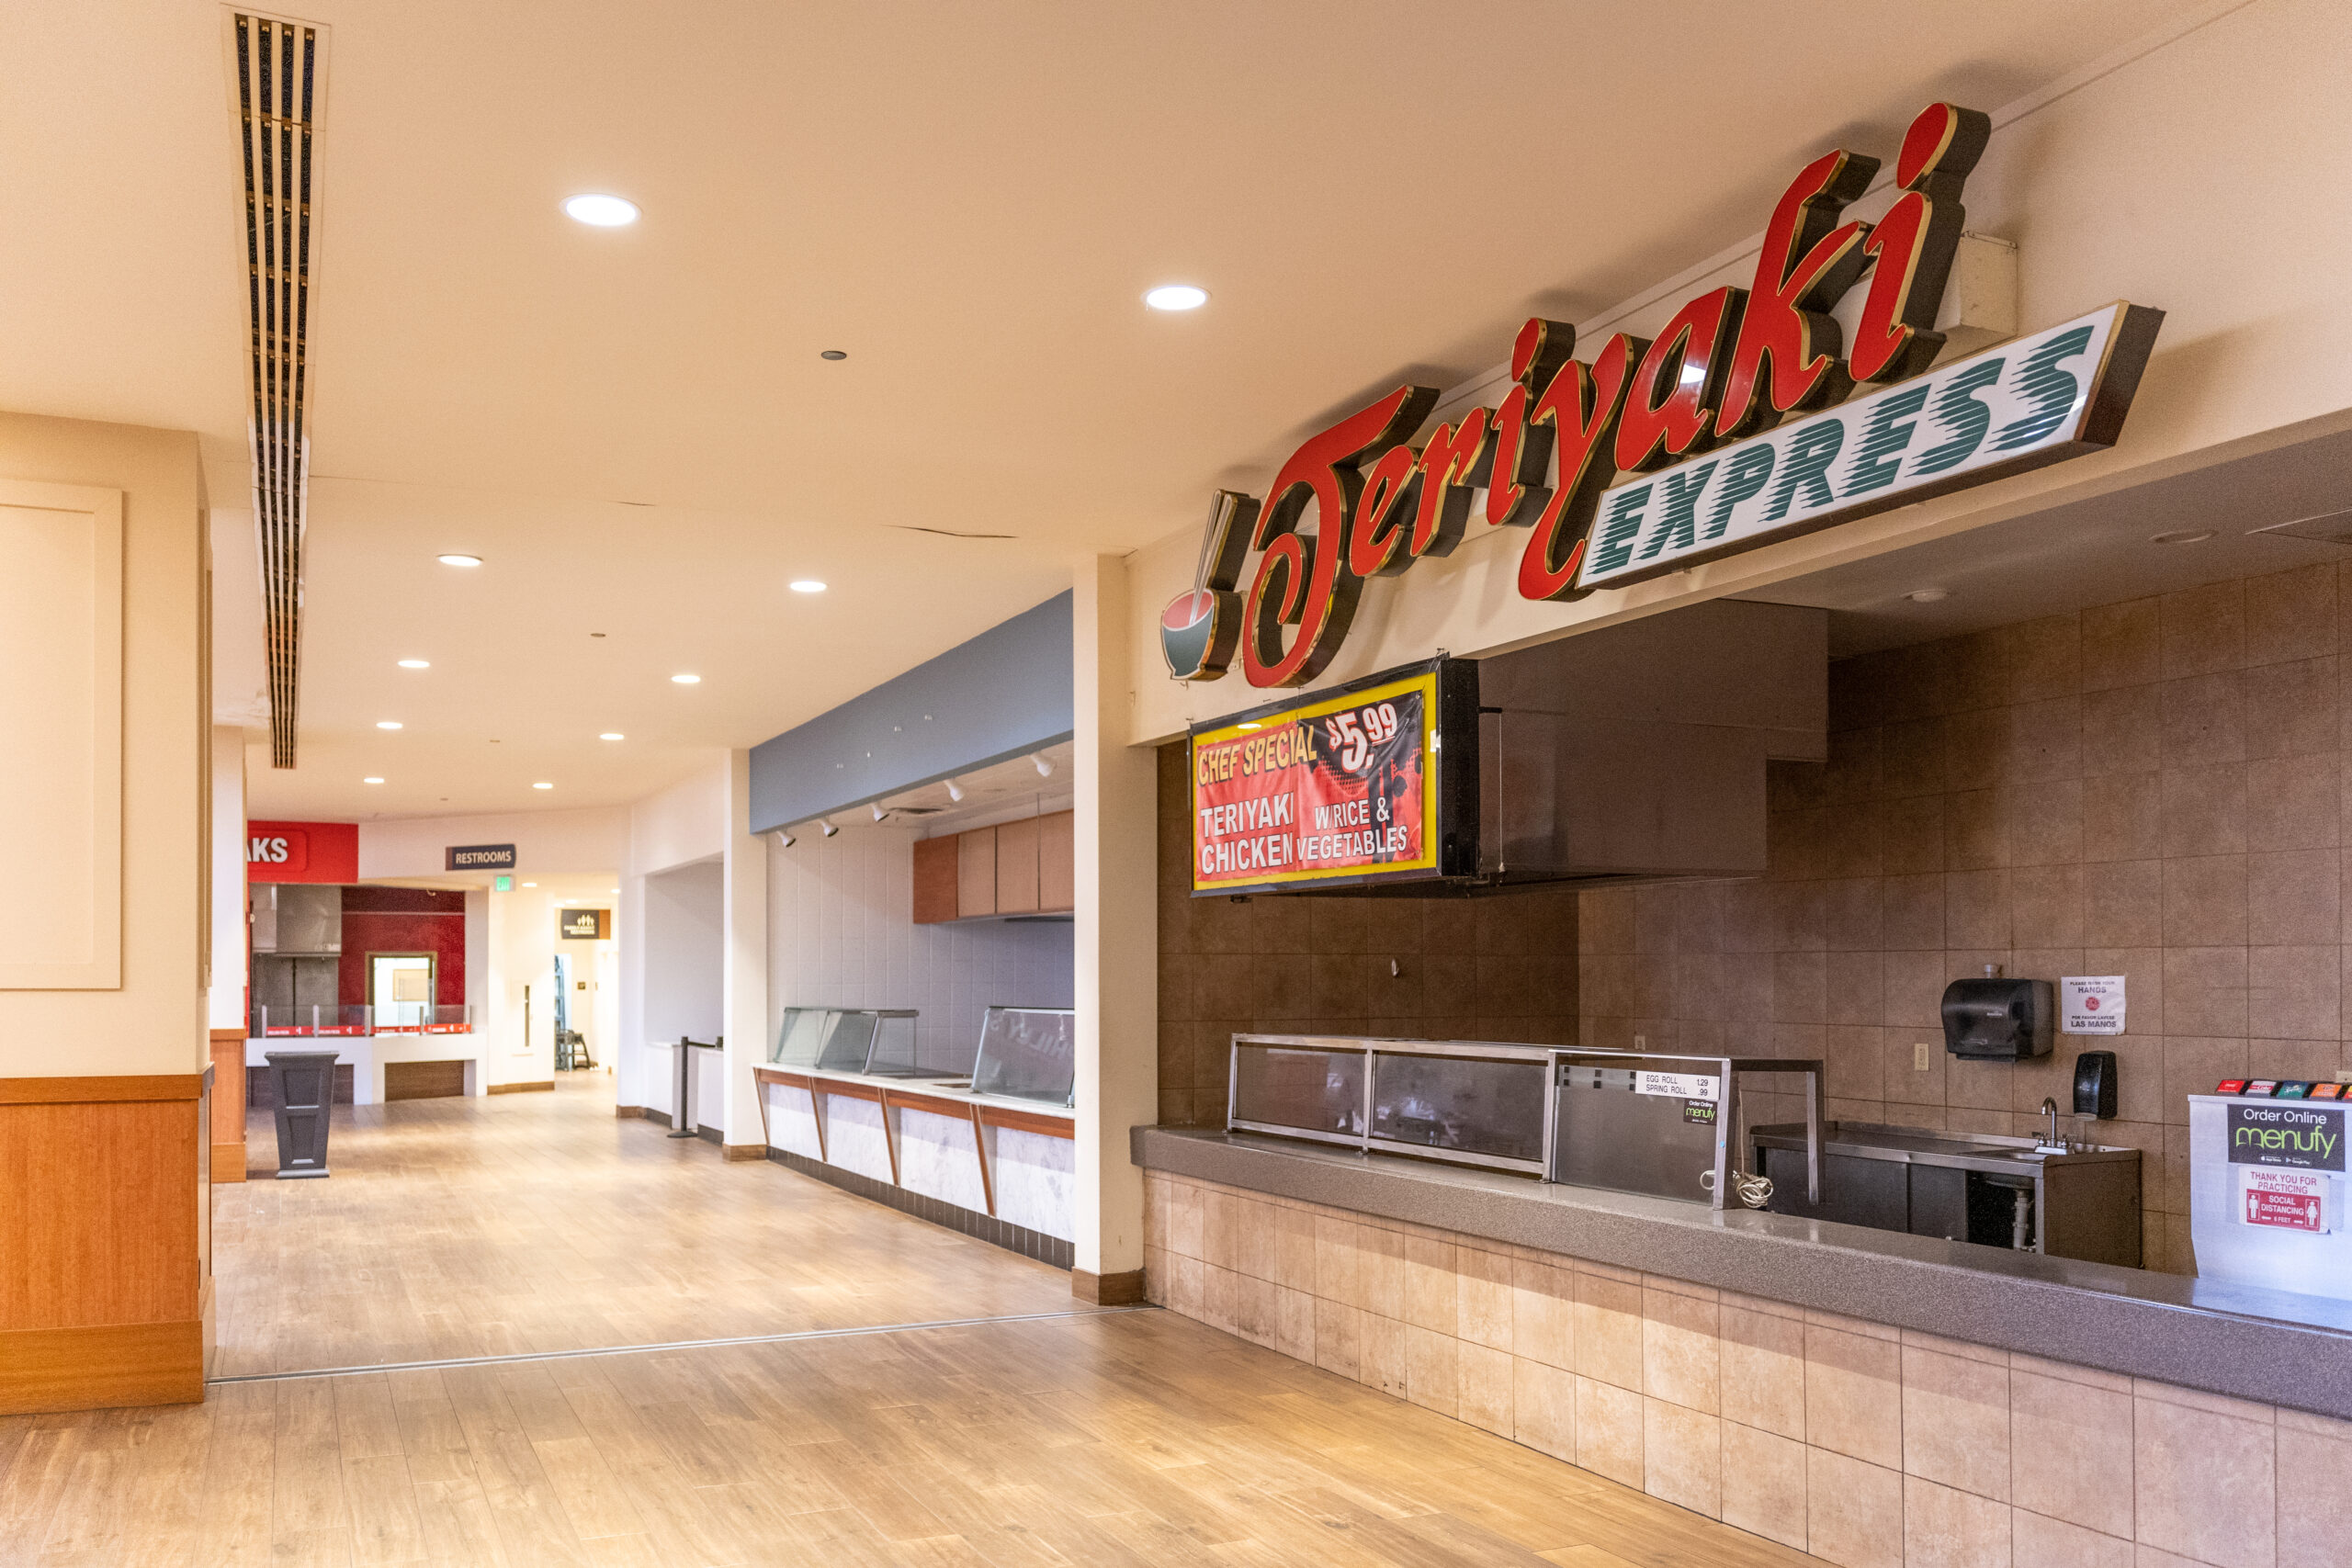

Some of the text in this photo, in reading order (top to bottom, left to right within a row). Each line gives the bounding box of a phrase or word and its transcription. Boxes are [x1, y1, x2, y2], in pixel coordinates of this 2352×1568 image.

[1243, 101, 1962, 689] Teriyaki
[1586, 324, 2097, 575] EXPRESS
[1325, 703, 1398, 773] $5.99
[1198, 725, 1317, 787] CHEF SPECIAL
[1200, 792, 1294, 838] TERIYAKI
[1376, 797, 1390, 822] &
[246, 837, 288, 863] KS
[1202, 831, 1293, 874] CHICKEN
[1296, 825, 1408, 862] VEGETABLES
[456, 851, 512, 864] RESTROOMS
[1645, 1075, 1659, 1083] EGG
[1661, 1076, 1678, 1085] ROLL
[1645, 1084, 1668, 1093] SPRING
[1670, 1086, 1687, 1095] ROLL
[1685, 1106, 1715, 1122] menufy
[2244, 1108, 2327, 1124] Order Online
[2235, 1125, 2337, 1159] menufy
[2250, 1171, 2317, 1186] THANK YOU FOR
[2257, 1181, 2309, 1194] PRACTICING
[2261, 1203, 2304, 1216] DISTANCING
[2268, 1195, 2296, 1205] SOCIAL
